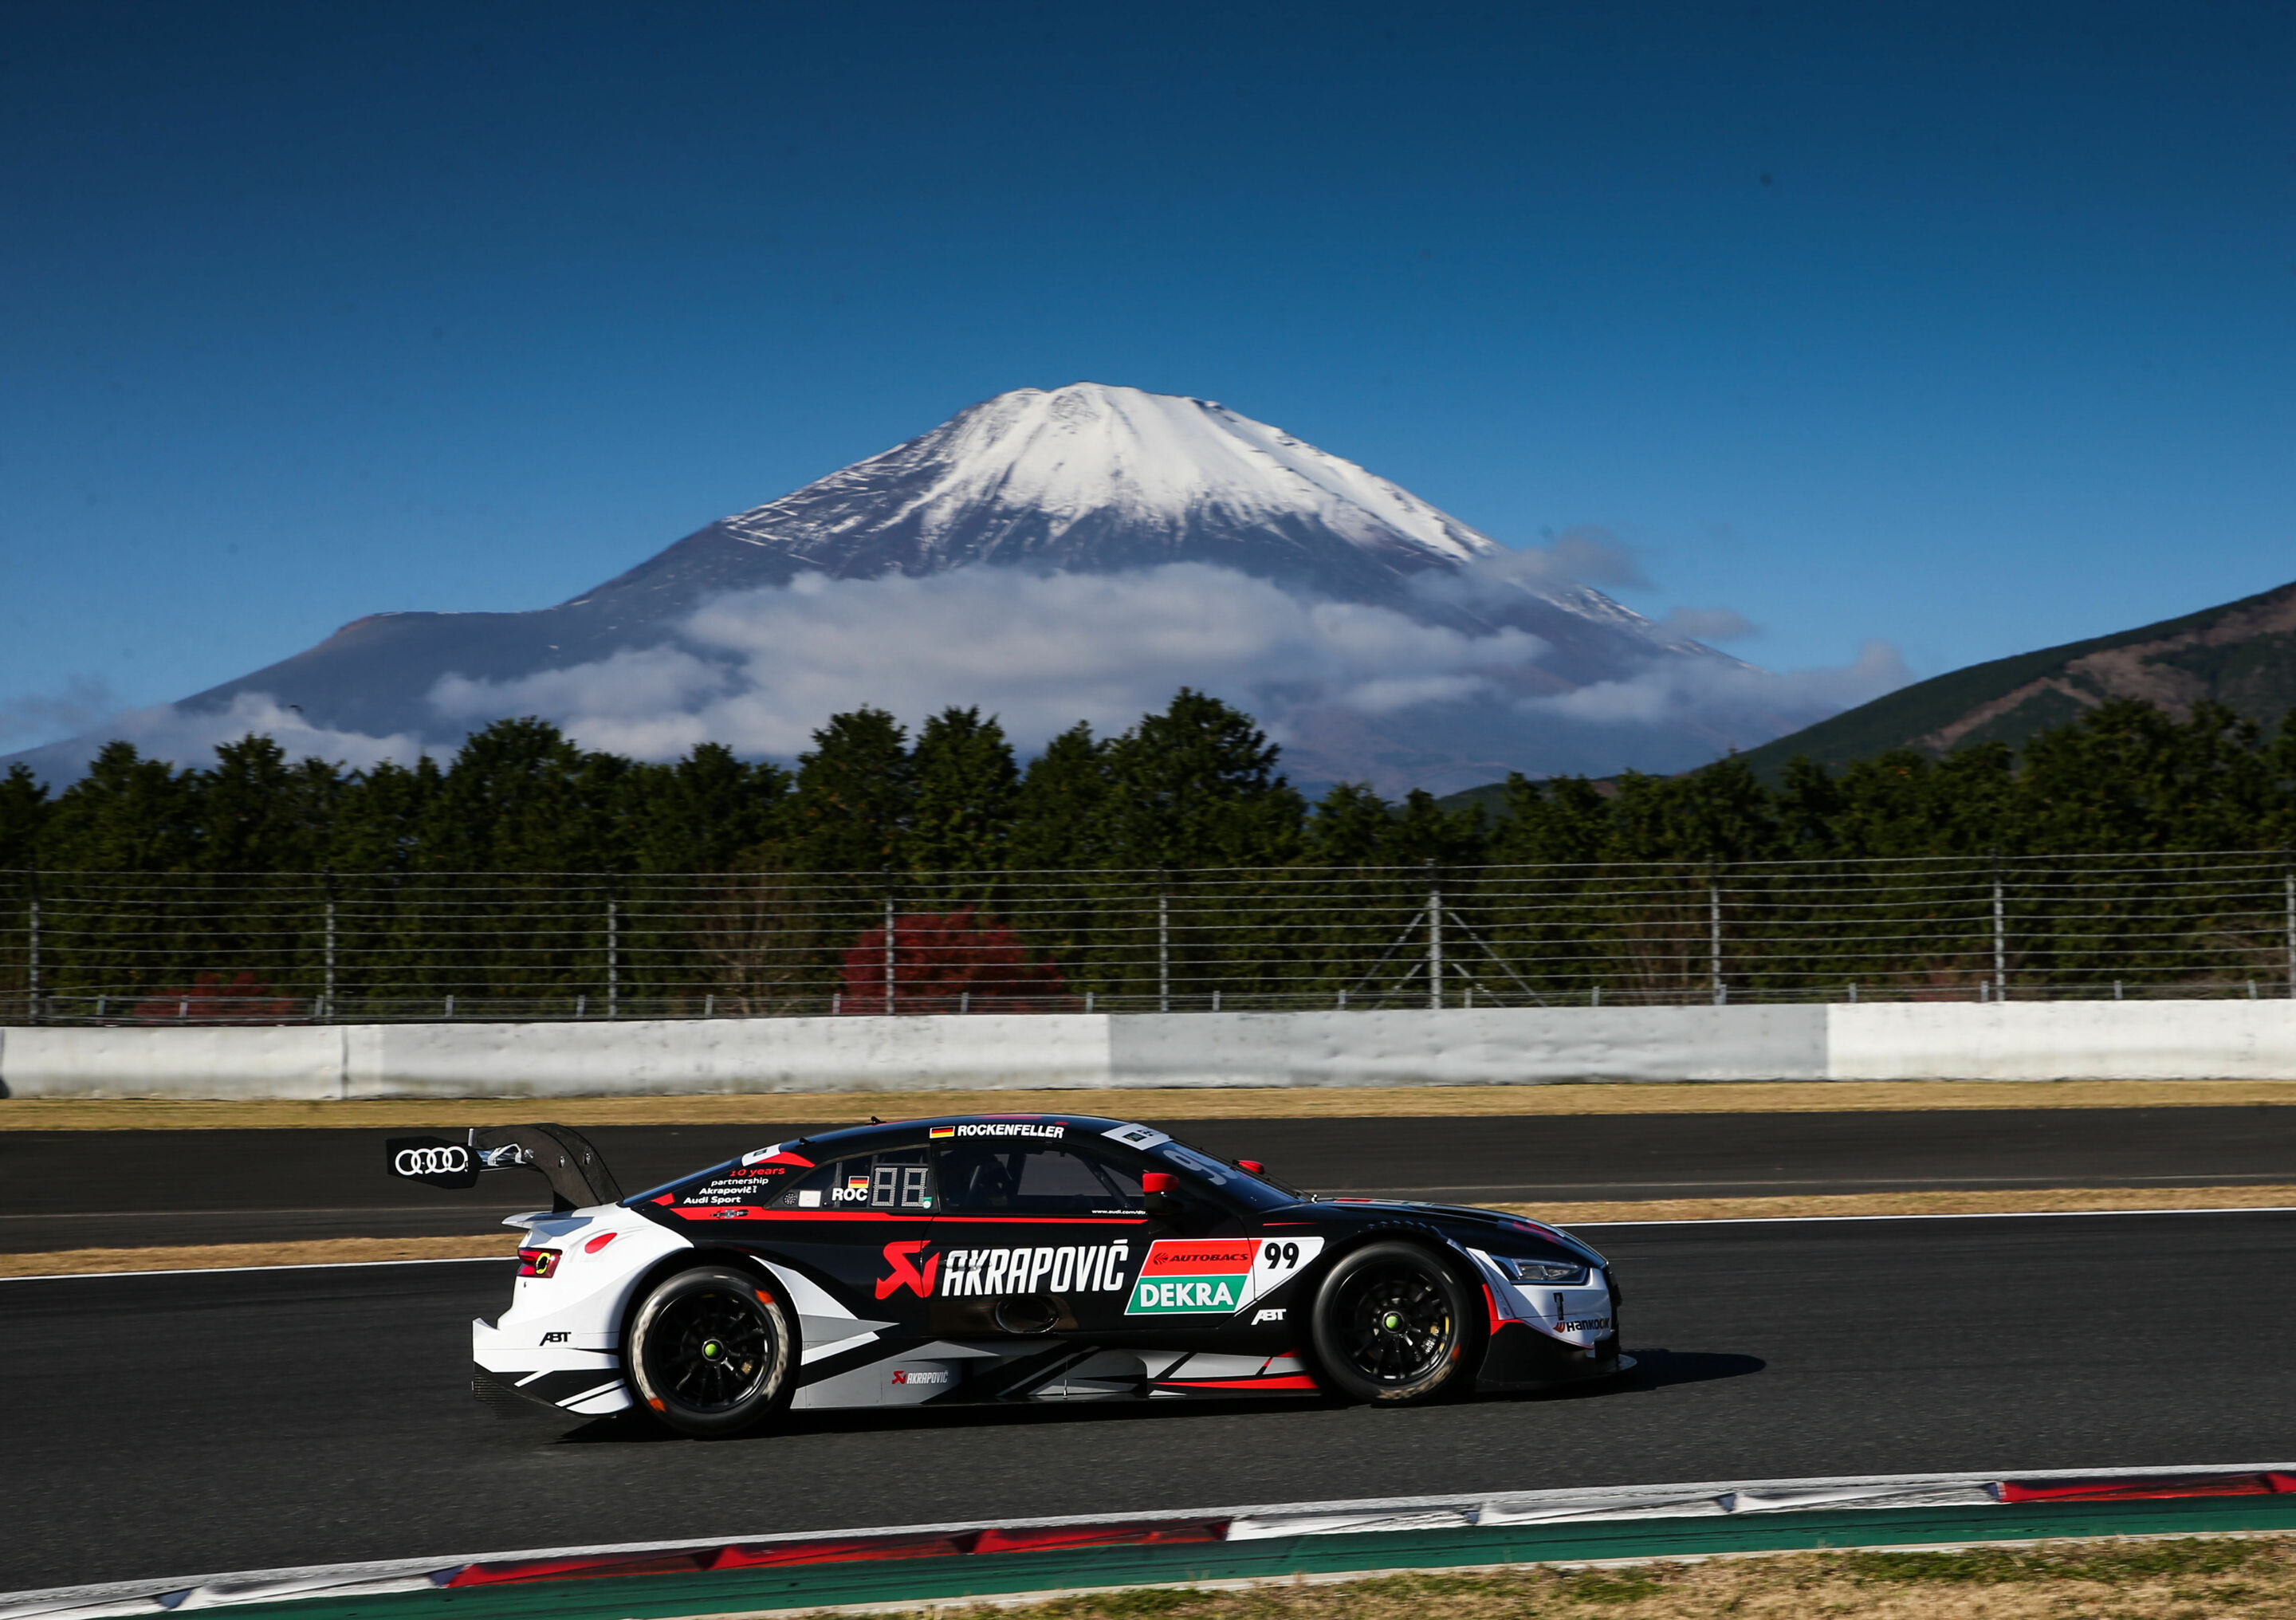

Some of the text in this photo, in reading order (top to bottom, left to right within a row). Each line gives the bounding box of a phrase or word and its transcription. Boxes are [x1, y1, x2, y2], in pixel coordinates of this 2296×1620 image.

[957, 1124, 1064, 1138] ROCKENFELLER
[749, 1167, 785, 1178] years
[710, 1178, 769, 1187] partnership
[710, 1196, 741, 1205] Sport
[832, 1187, 868, 1201] ROC
[1170, 1253, 1248, 1262] AUTOBACS
[1264, 1242, 1299, 1269] 99
[942, 1239, 1129, 1297] AKRAPOVIČ
[1140, 1282, 1234, 1307] DEKRA
[1251, 1308, 1287, 1325] ABT
[539, 1331, 572, 1347] ABT
